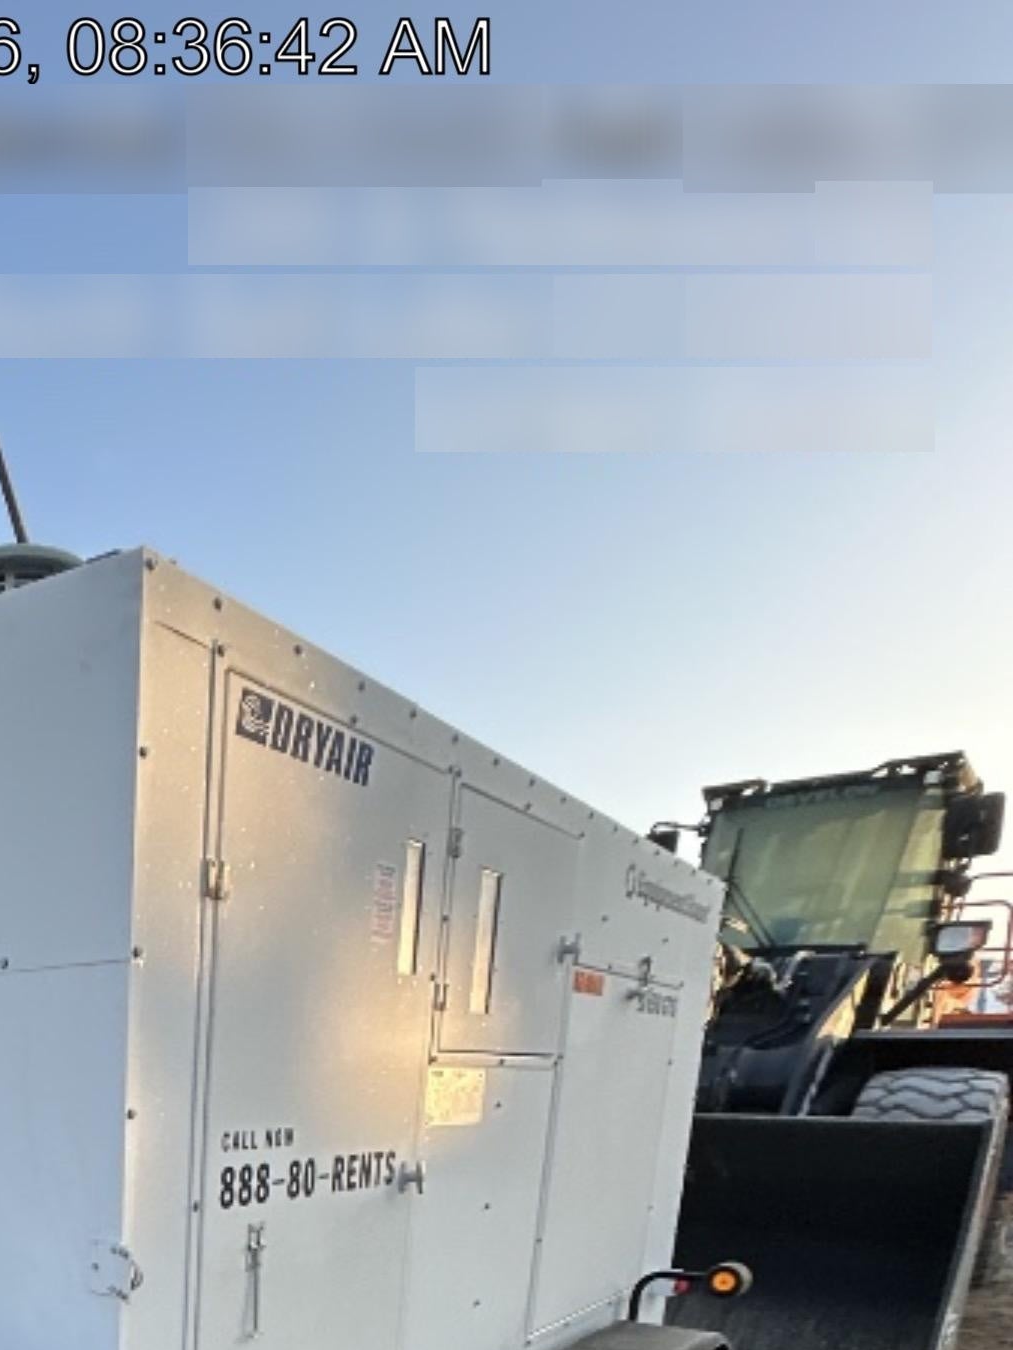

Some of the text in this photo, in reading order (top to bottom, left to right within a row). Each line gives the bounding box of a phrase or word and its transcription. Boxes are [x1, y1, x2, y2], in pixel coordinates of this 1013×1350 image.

[269, 702, 375, 787] DRYAIR
[221, 1127, 294, 1152] CALL NOW
[219, 1151, 396, 1209] 888-80-RENTS
